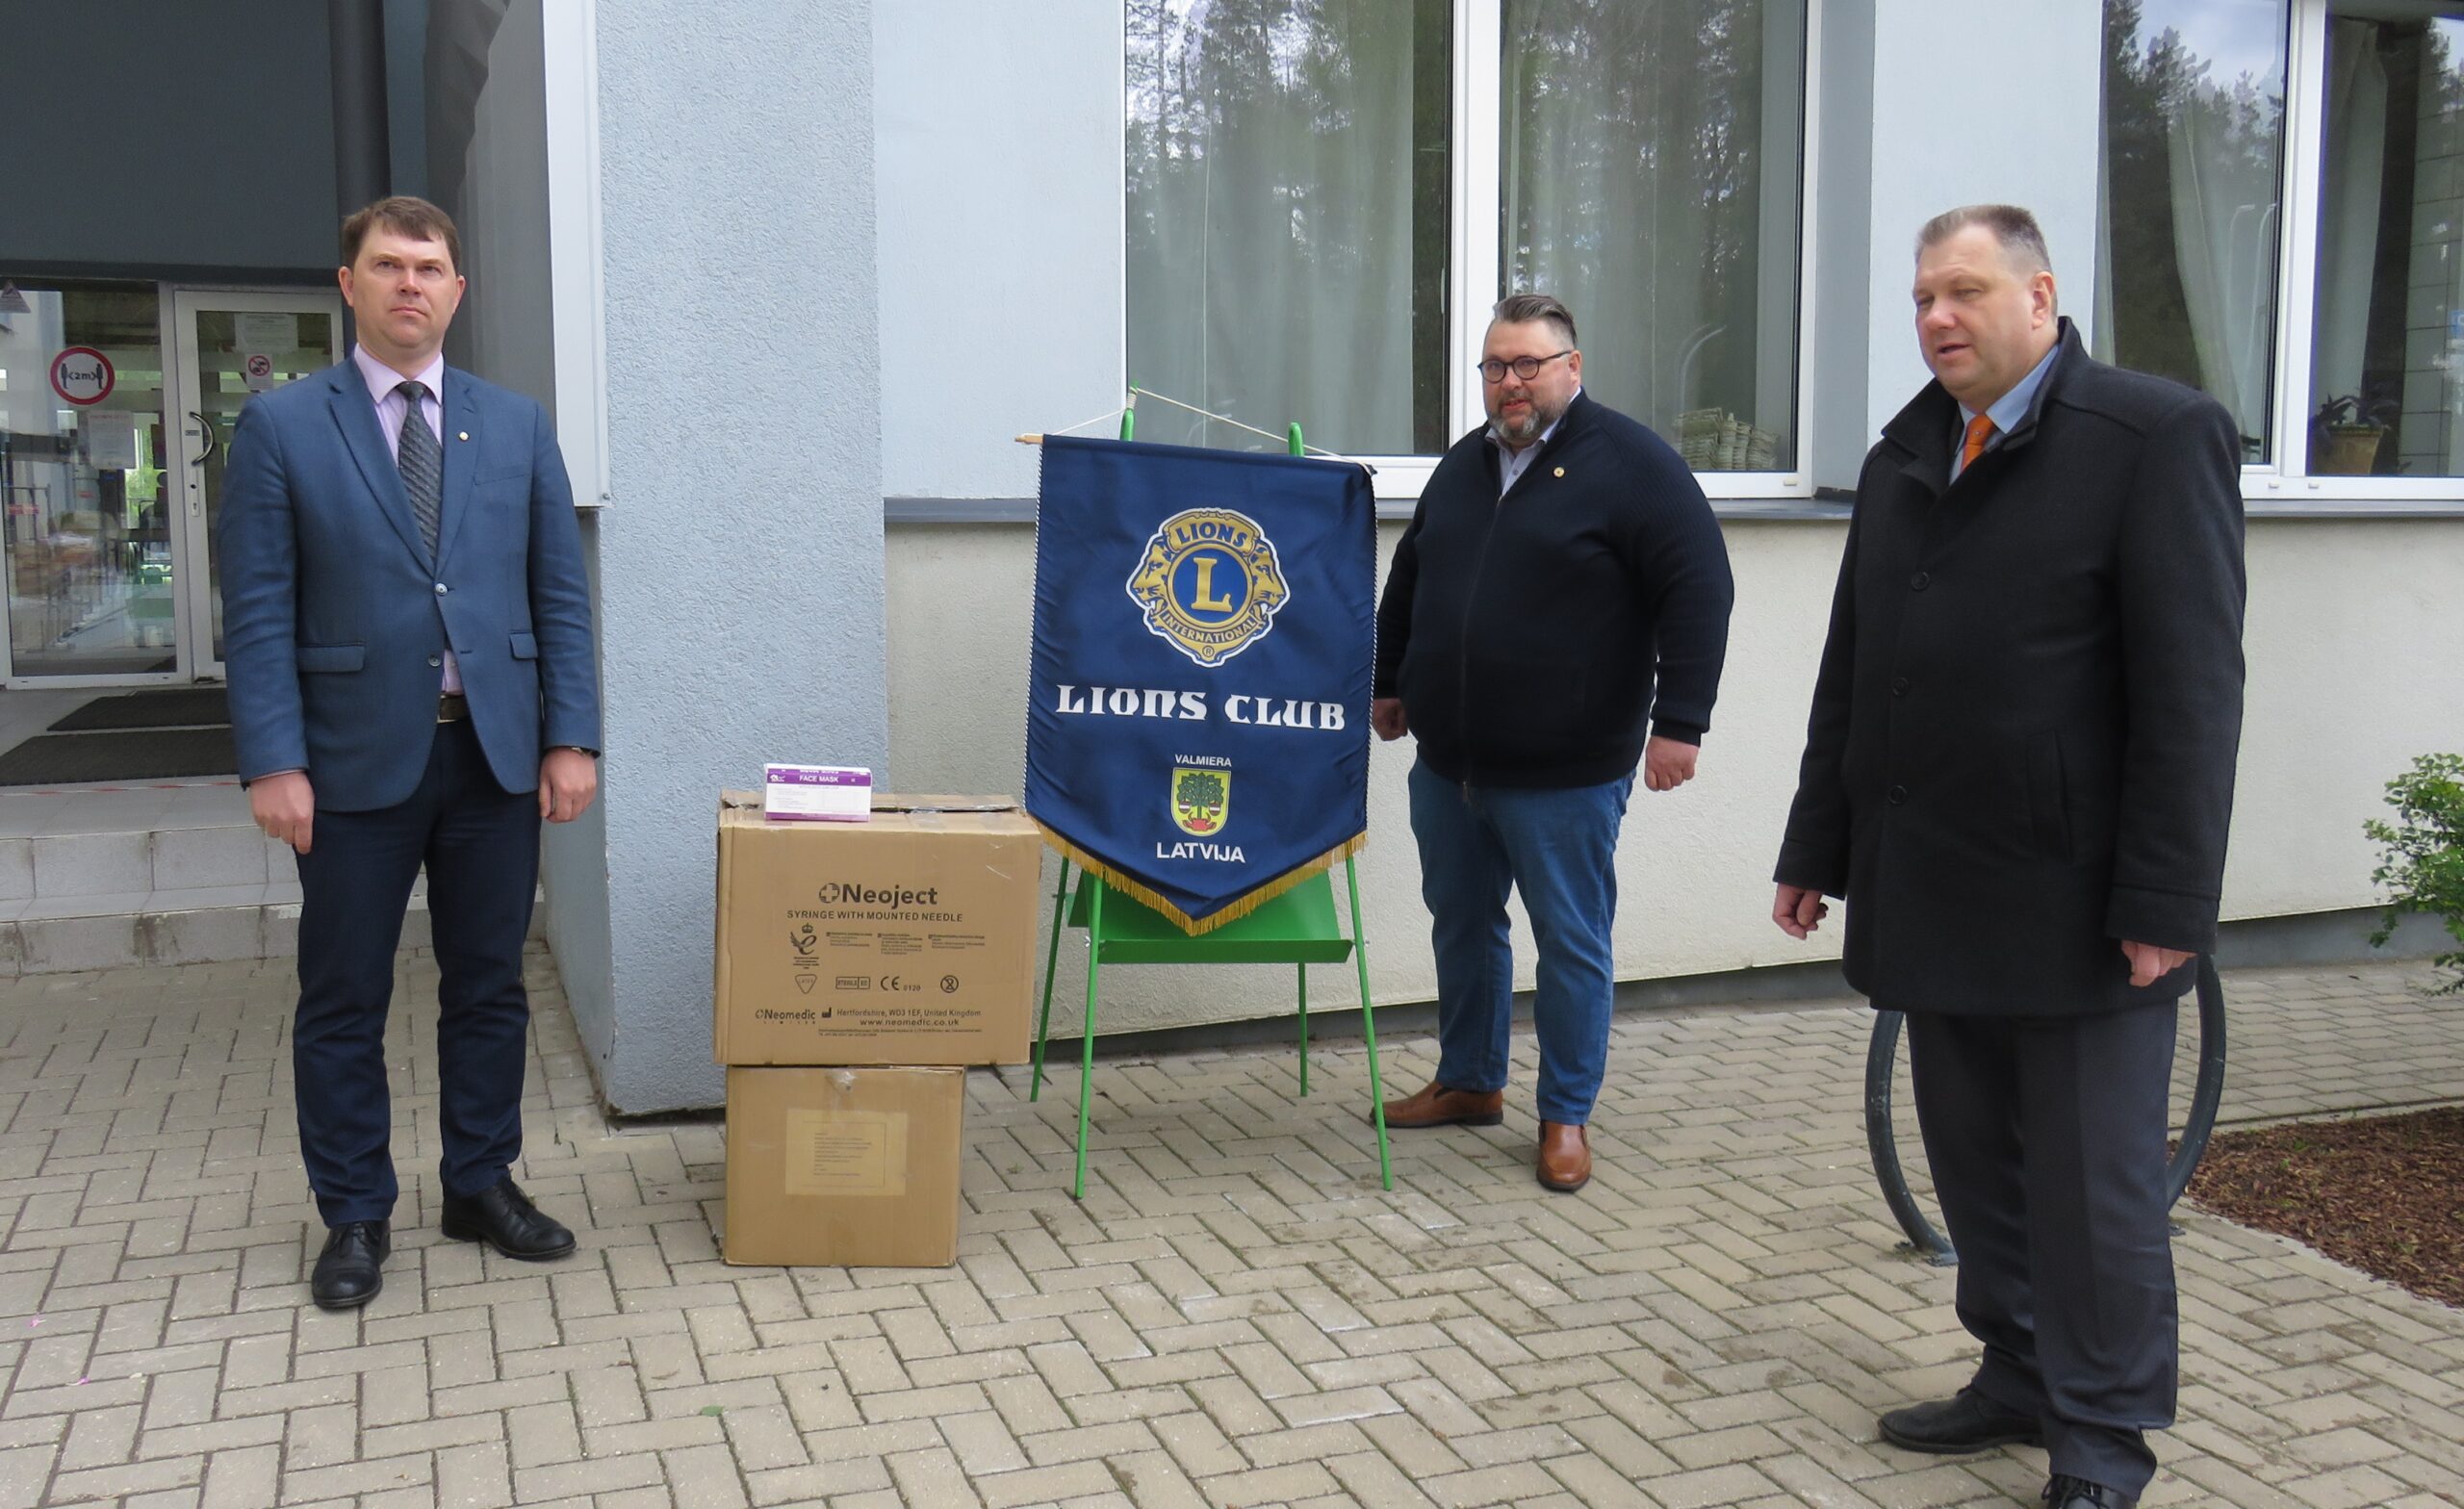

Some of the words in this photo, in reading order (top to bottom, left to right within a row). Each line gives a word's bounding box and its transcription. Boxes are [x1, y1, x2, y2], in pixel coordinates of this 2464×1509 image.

[1175, 522, 1247, 548] LIONS
[1191, 556, 1233, 612] L
[1161, 610, 1257, 644] INTERNATIONAL
[1056, 684, 1208, 721] LIONS
[1223, 693, 1347, 731] CLUB
[1174, 754, 1232, 768] VALMIERA
[819, 775, 839, 783] MASK
[1156, 841, 1246, 863] LATVIJA
[842, 883, 938, 909] Neoject
[786, 909, 834, 920] SYRINGE
[836, 910, 864, 920] WITH
[866, 911, 919, 922] MOUNTED
[921, 912, 963, 923] NEEDLE
[763, 1008, 816, 1020] Neomedic
[836, 1009, 887, 1018] Hertfordshire,
[924, 1009, 948, 1017] United
[949, 1009, 981, 1018] Kingdom
[860, 1018, 960, 1027] www.neomedic.co.uk
